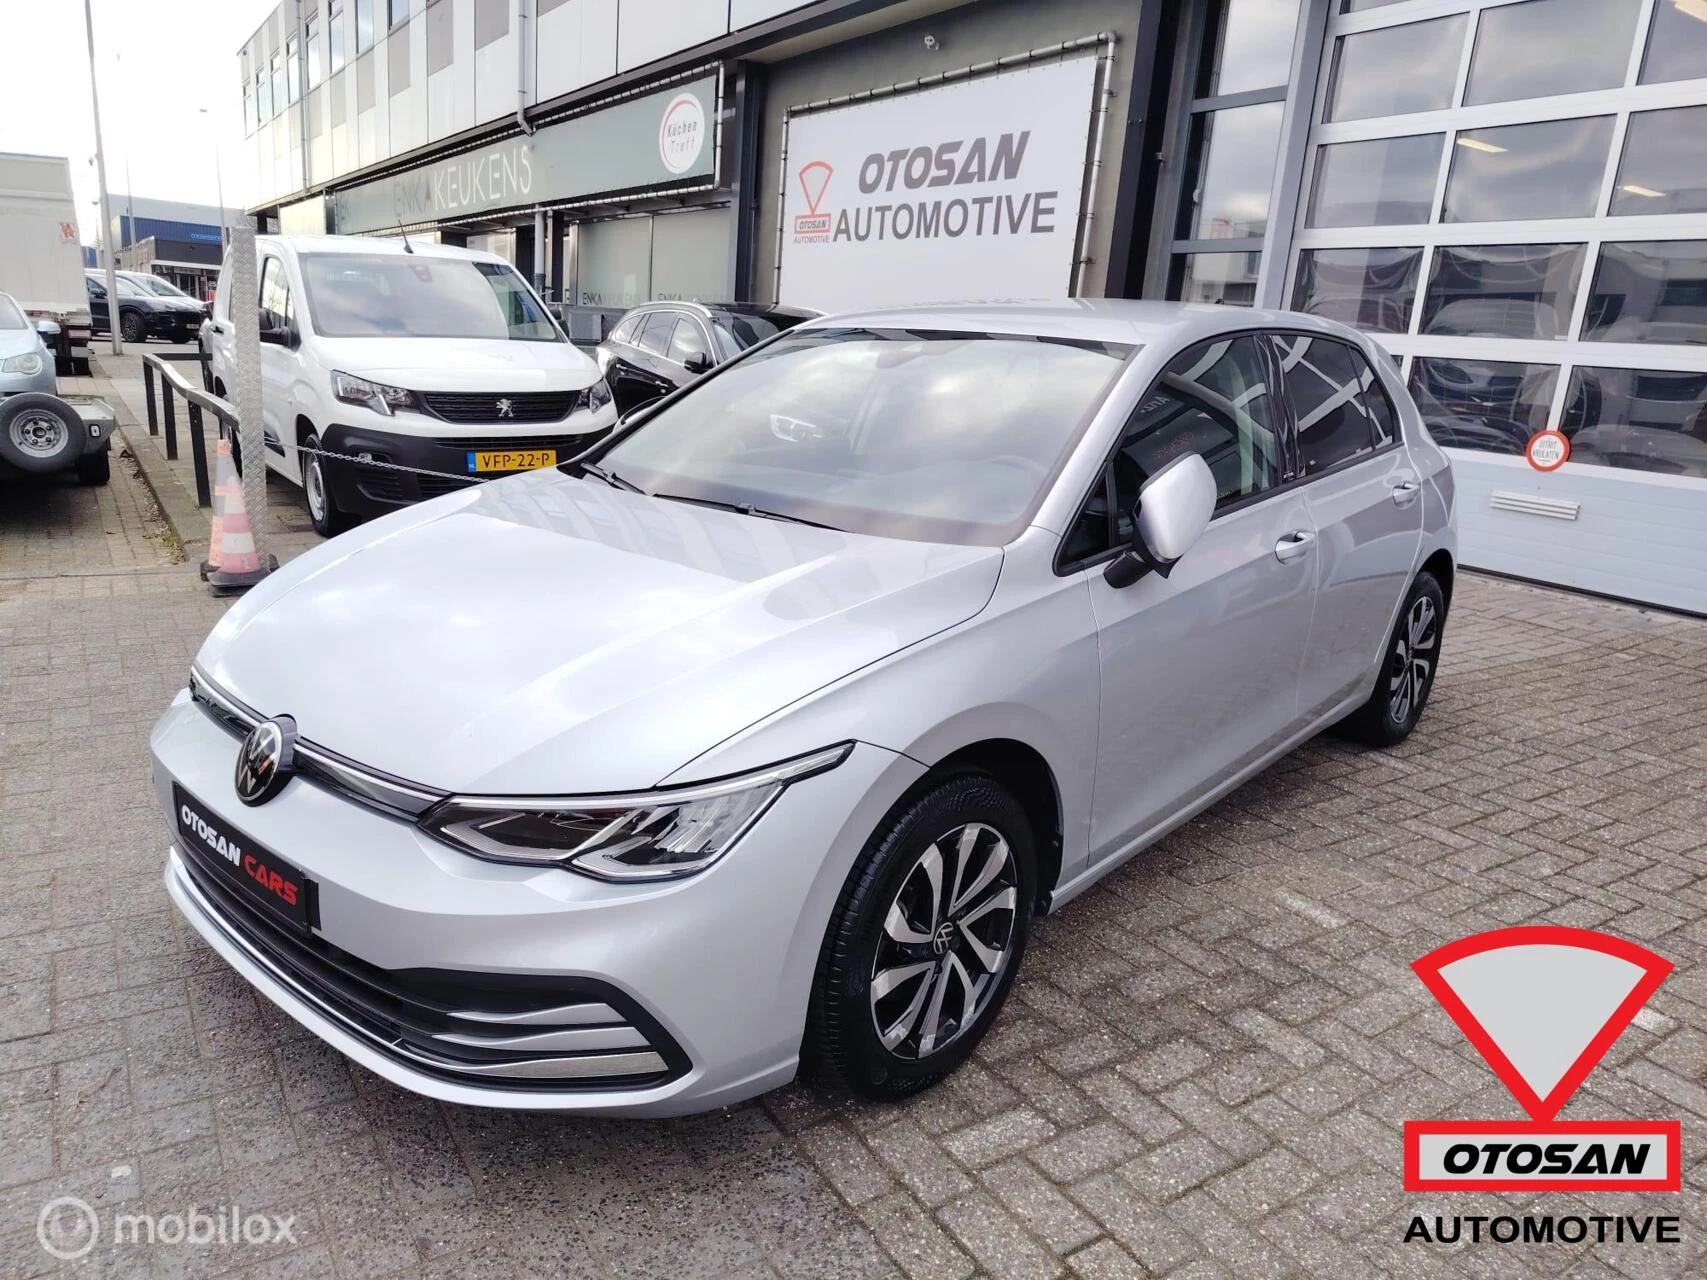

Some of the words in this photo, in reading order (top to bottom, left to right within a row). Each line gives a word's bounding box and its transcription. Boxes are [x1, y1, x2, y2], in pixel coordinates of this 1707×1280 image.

[433, 144, 532, 210] KEUKENS
[858, 130, 1032, 194] OTOSAN
[800, 220, 826, 230] OTOSAN
[832, 191, 1058, 242] AUTOMOTIVE
[794, 235, 830, 244] AUTOMOTIVE
[583, 292, 602, 305] ENKA
[482, 452, 550, 469] VFP-22-P
[181, 805, 241, 866] OTOSAN
[244, 853, 298, 906] CARS
